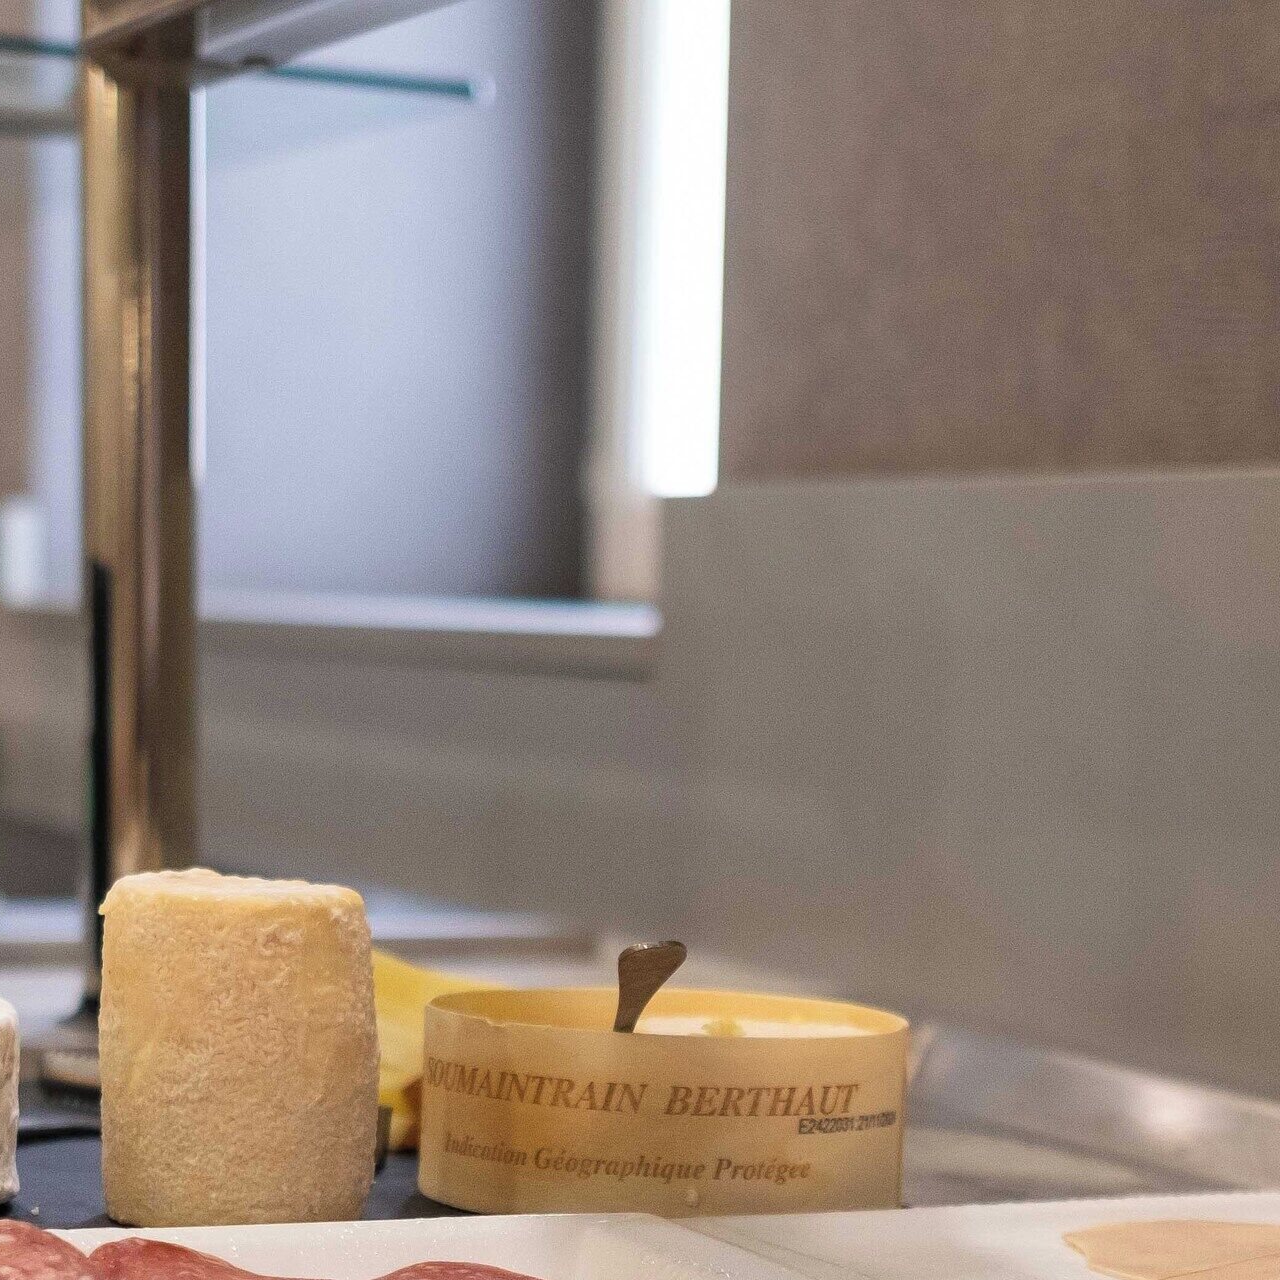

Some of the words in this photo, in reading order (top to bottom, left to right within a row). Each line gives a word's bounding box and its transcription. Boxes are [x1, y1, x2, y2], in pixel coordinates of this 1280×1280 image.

[663, 1083, 861, 1117] BERTHAUT
[444, 1131, 528, 1167] Indication
[533, 1147, 707, 1185] Géographique
